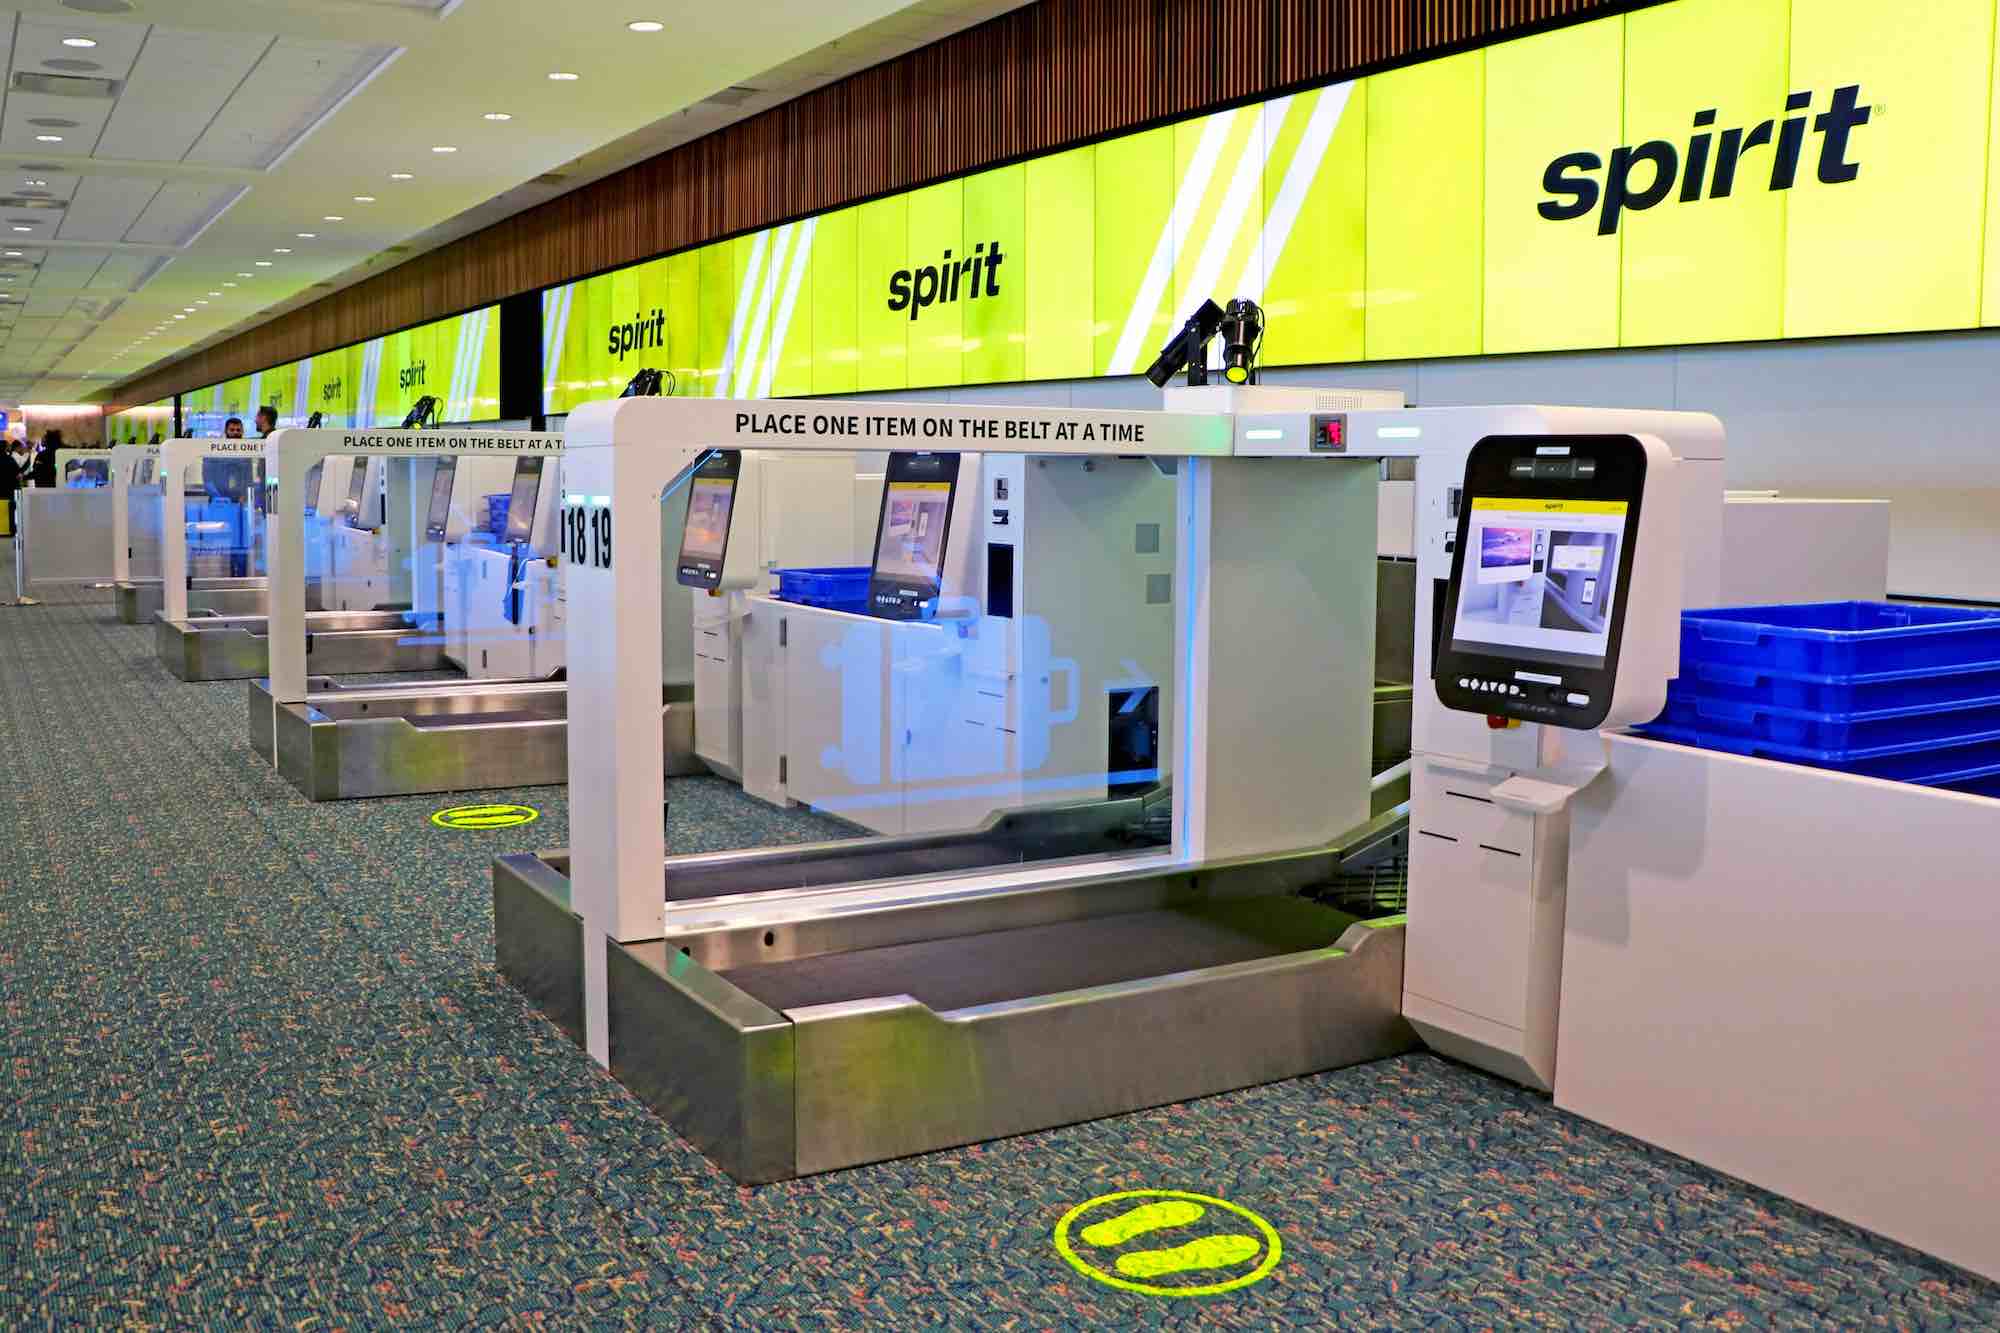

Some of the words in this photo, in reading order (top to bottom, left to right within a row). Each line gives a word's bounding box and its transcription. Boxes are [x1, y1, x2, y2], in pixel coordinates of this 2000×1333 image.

[1536, 84, 1872, 236] spirit
[887, 241, 1003, 321] spirit
[608, 308, 665, 362] spirit
[399, 359, 425, 393] spirit
[343, 436, 383, 448] PLACE
[386, 436, 413, 448] ONE
[416, 437, 446, 448] ITEM
[449, 437, 467, 448] ON
[471, 438, 494, 448] THE
[497, 438, 524, 449] BELT
[528, 439, 542, 449] AT
[544, 439, 553, 449] A
[735, 413, 806, 434] PLACE
[813, 415, 859, 435] ONE
[866, 416, 916, 437] ITEM
[922, 418, 953, 438] ON
[959, 419, 999, 438] THE
[1005, 420, 1051, 440] BELT
[1055, 422, 1079, 441] AT
[1082, 423, 1095, 441] A
[1100, 423, 1145, 442] TIME
[568, 506, 586, 565] 18
[591, 507, 612, 569] 19
